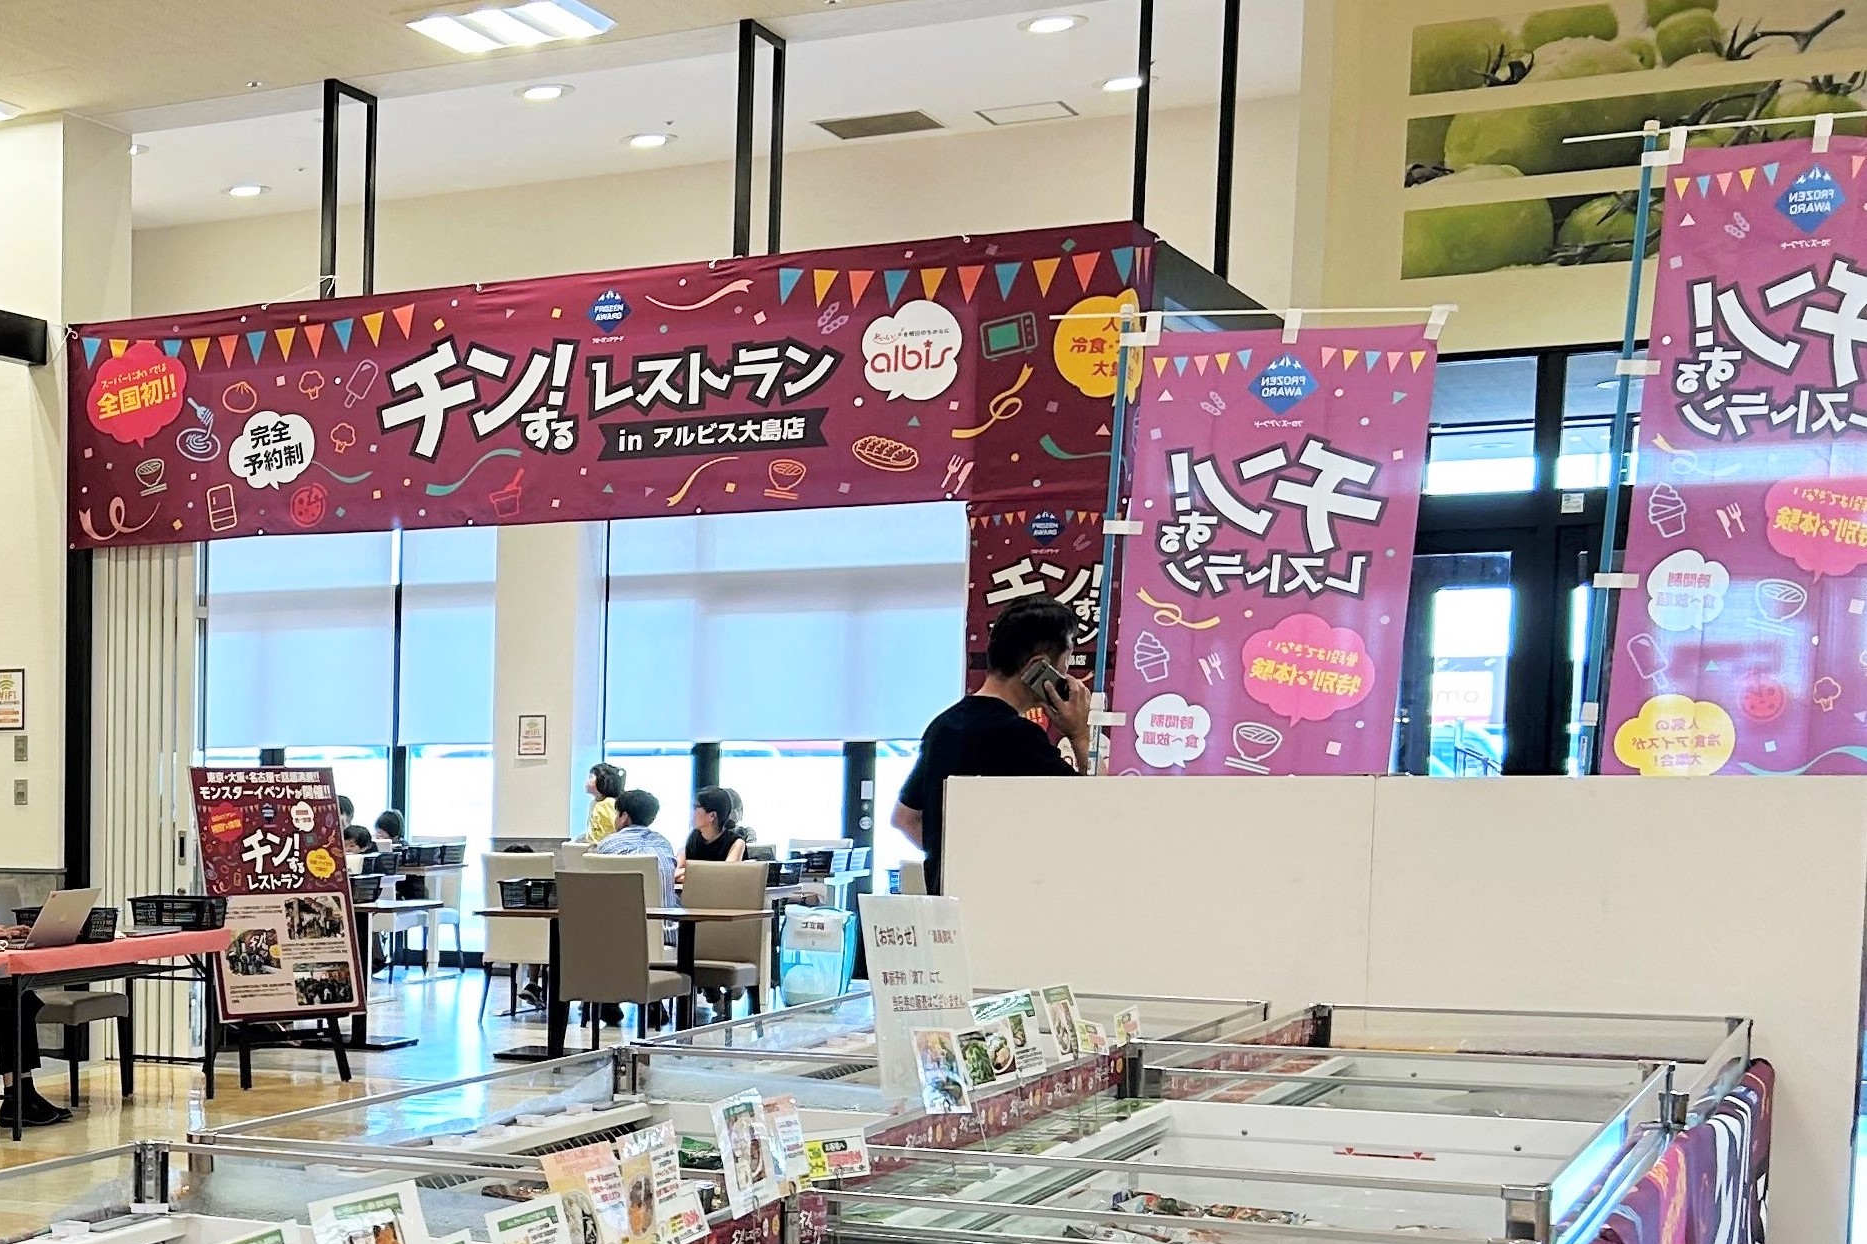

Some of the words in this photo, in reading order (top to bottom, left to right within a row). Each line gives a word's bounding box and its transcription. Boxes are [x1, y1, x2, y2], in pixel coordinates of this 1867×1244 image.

[594, 303, 624, 313] FROZEN
[595, 312, 623, 322] AWARD
[871, 340, 953, 373] albis
[591, 345, 835, 411] レストラン
[97, 374, 177, 420] 全国初!!
[382, 340, 579, 458] チン!
[250, 420, 291, 449] 完全
[521, 407, 574, 450] する
[619, 429, 643, 452] in
[653, 417, 806, 449] アルビス大島店
[243, 442, 304, 476] 予約制
[242, 829, 300, 873] チン!
[247, 874, 304, 890] レストラン
[873, 925, 918, 948] 【お知らせ】
